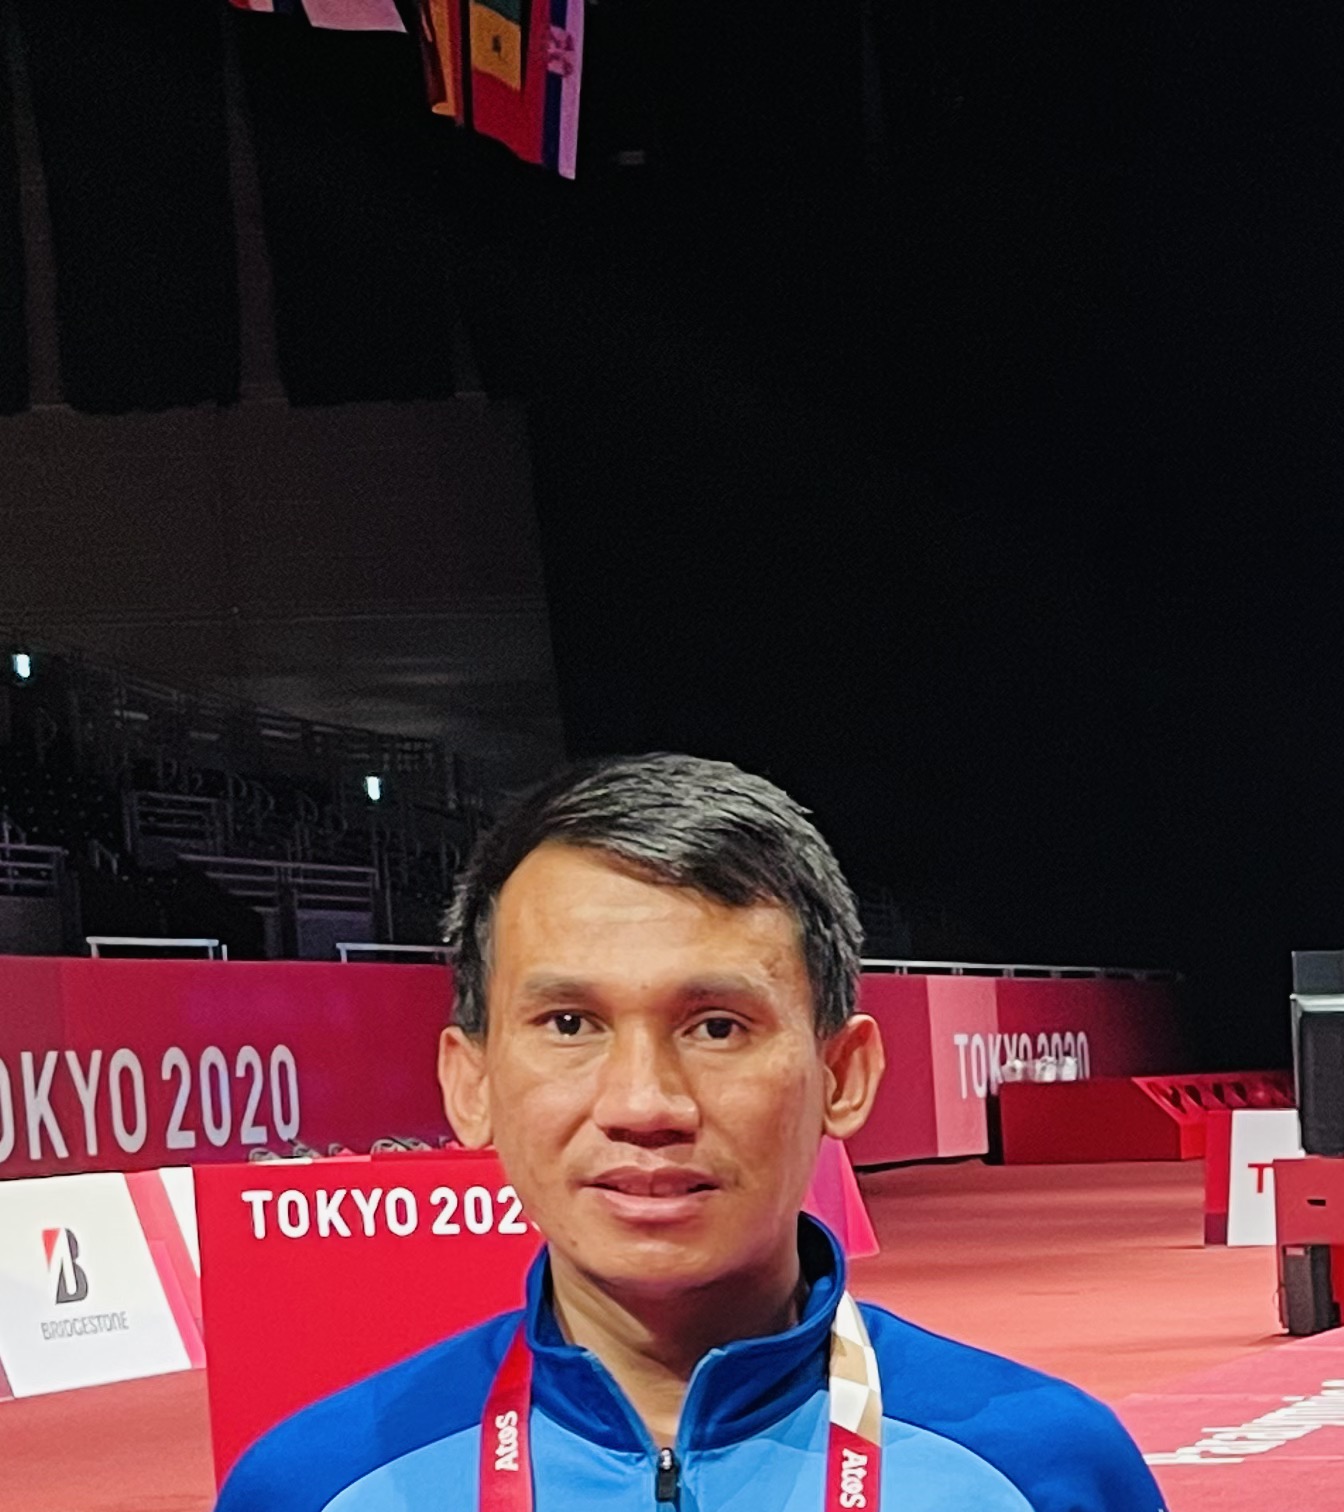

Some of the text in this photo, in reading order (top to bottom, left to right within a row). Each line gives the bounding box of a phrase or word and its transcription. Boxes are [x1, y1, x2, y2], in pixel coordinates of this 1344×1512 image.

[161, 1044, 301, 1149] 2020
[241, 1184, 541, 1240] TOKYO 202
[41, 1311, 130, 1340] BRIDGESTONE
[495, 1410, 519, 1472] Atos
[839, 1448, 868, 1509] Atos
